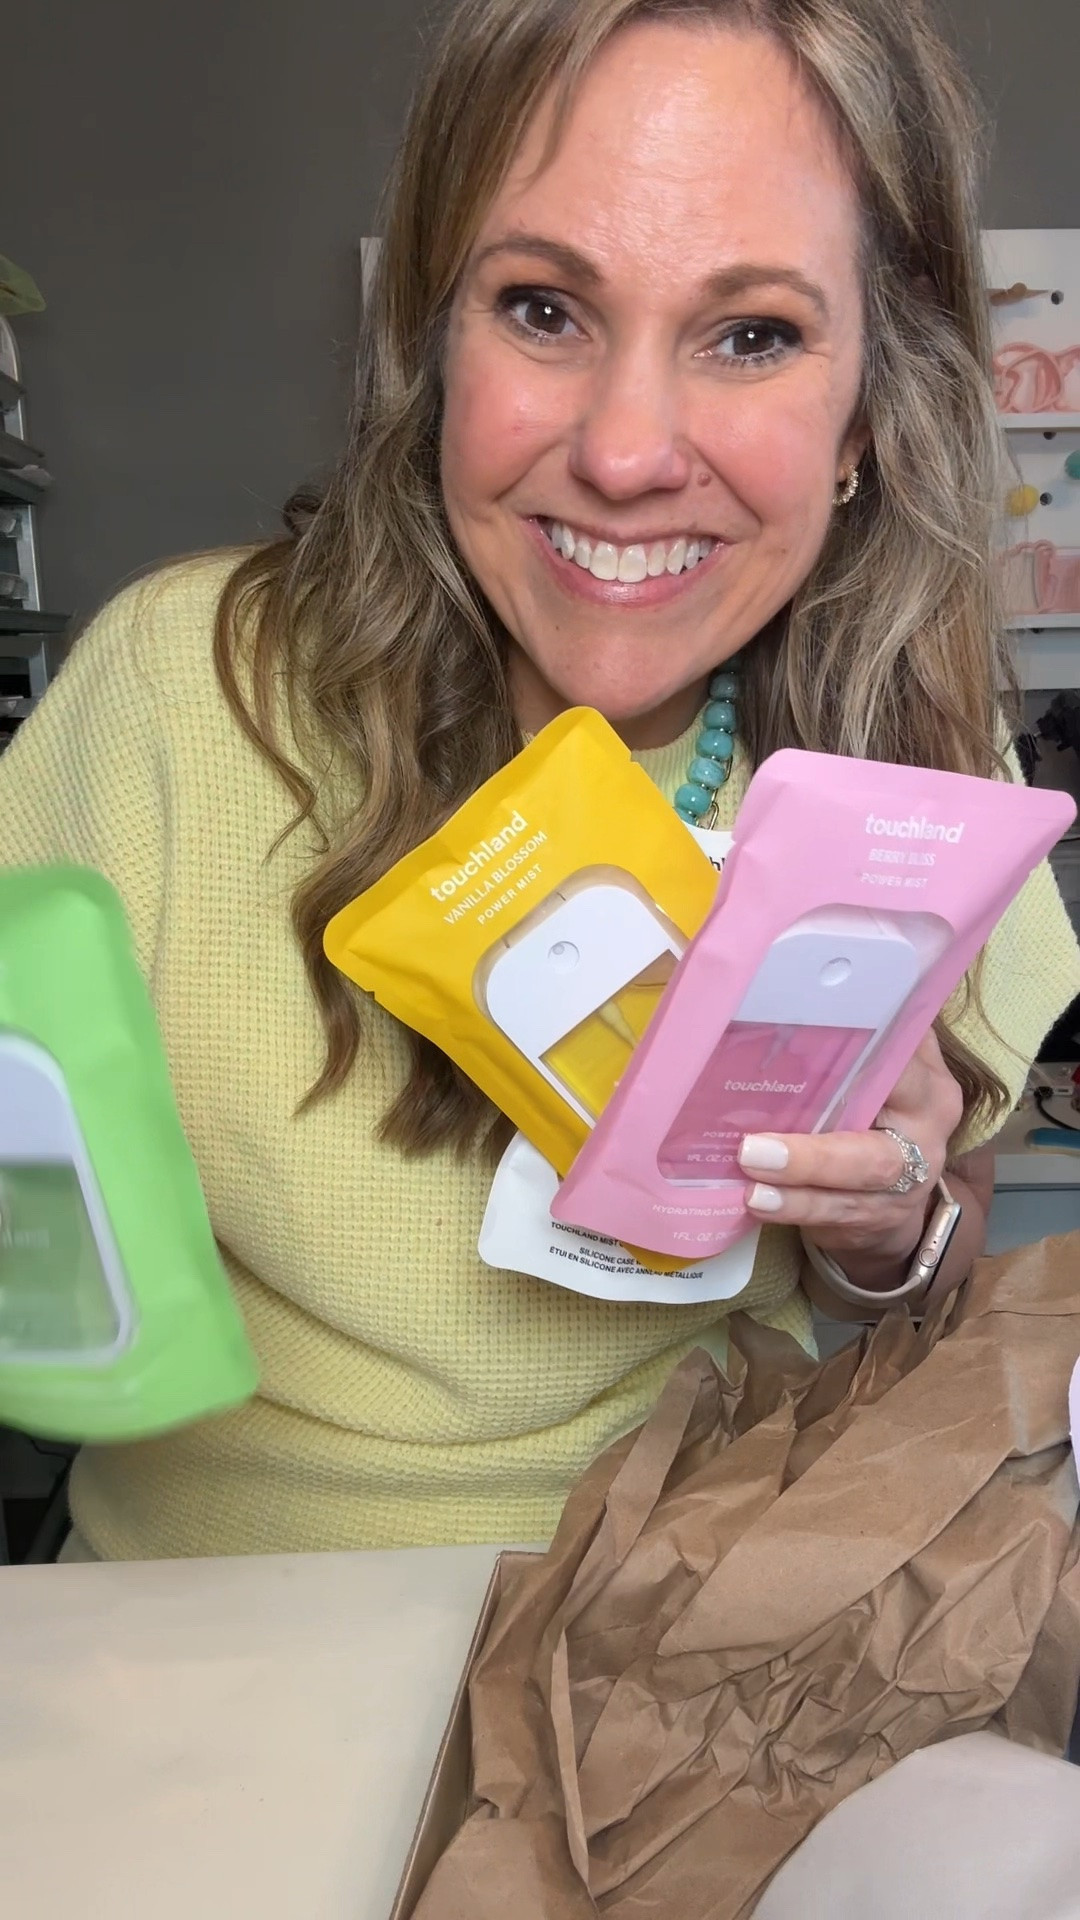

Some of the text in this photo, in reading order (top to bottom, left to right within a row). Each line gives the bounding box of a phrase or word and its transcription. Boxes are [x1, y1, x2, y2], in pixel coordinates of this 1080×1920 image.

[865, 812, 965, 844] touchland
[430, 810, 528, 902] touchland
[443, 830, 548, 925] VANILLA BLOSSOM
[477, 863, 542, 925] POWER MIST
[724, 1079, 807, 1094] touchland
[702, 1131, 740, 1139] POWER
[652, 1204, 712, 1217] HYDRATING
[551, 1221, 598, 1242] TOUCHLAND
[600, 1236, 618, 1247] MIST
[568, 1252, 579, 1262] EN
[579, 1256, 616, 1273] SILICONE
[616, 1266, 635, 1274] AVEC
[579, 1246, 635, 1266] SILICONE CASE
